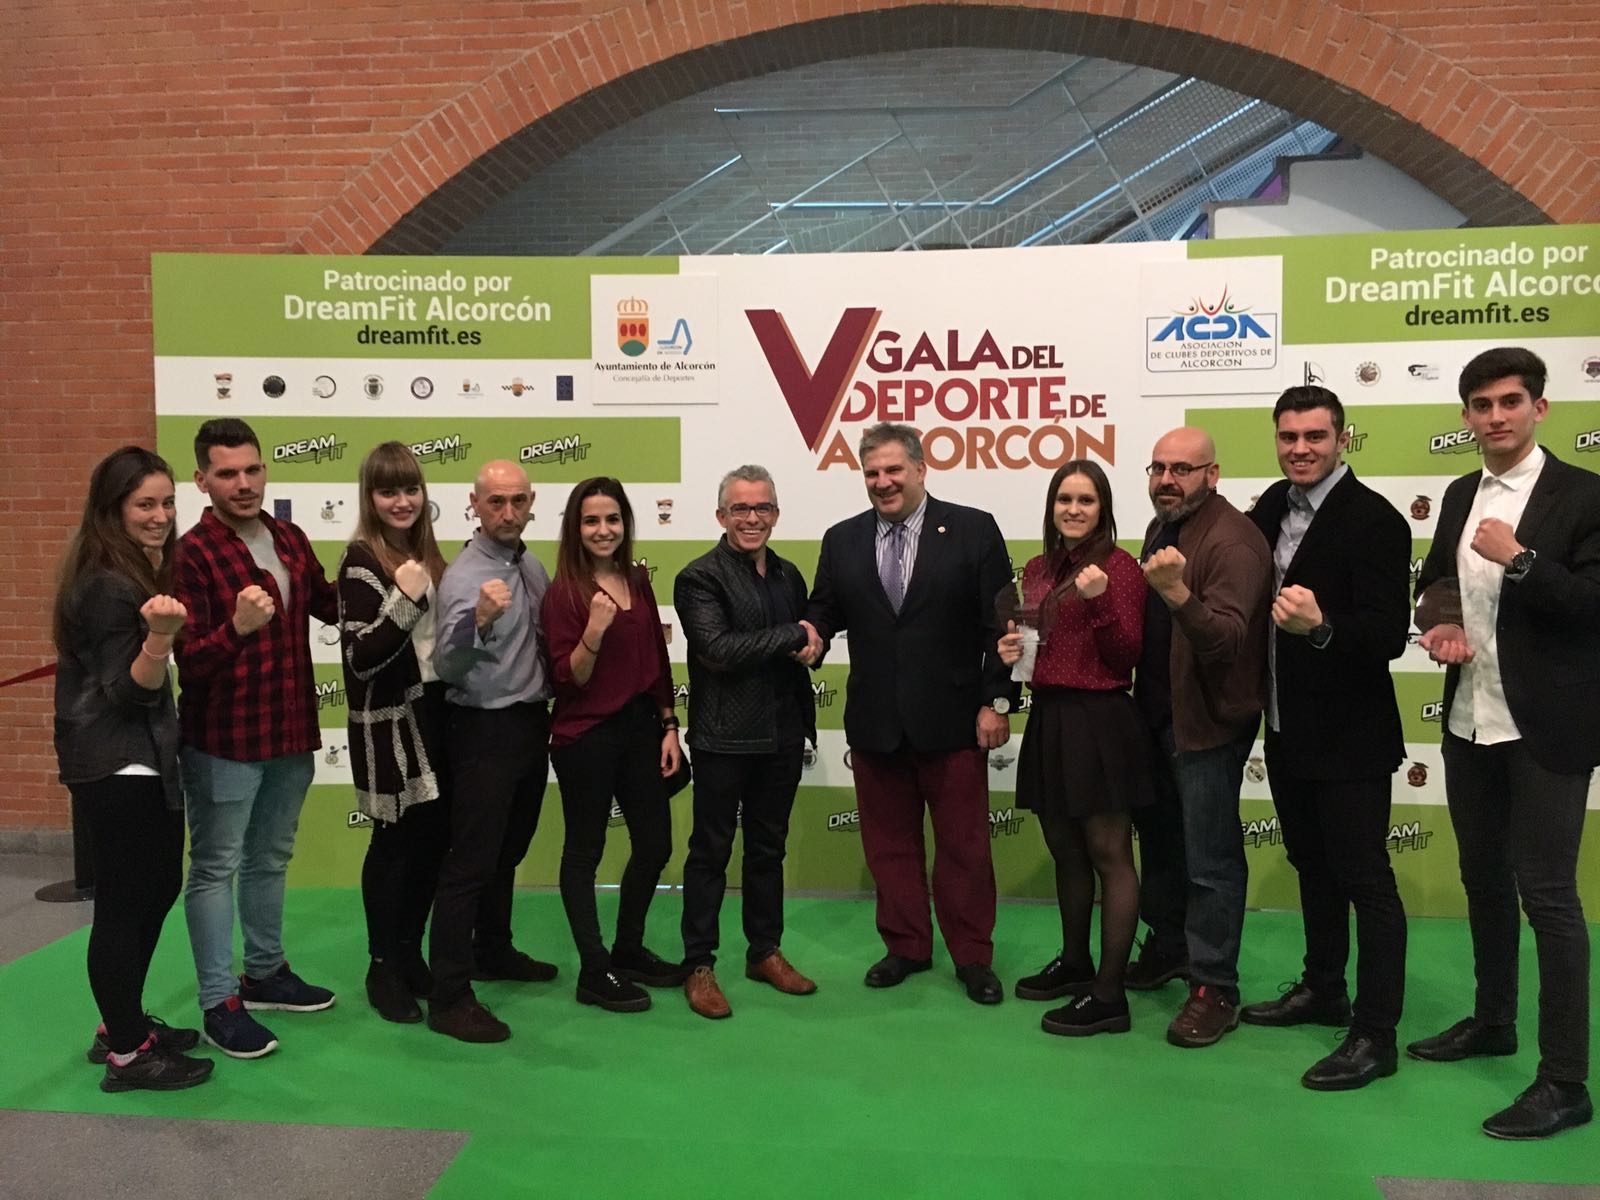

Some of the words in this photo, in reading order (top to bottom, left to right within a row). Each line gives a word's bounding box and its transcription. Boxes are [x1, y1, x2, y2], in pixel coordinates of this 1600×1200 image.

[1370, 241, 1535, 270] Patrocinado
[1543, 245, 1589, 270] por
[323, 270, 467, 292] Patrocinado
[474, 275, 512, 297] por
[1325, 271, 1475, 303] DreamFit
[284, 294, 417, 321] DreamFit
[425, 295, 551, 322] Alcorcón
[1405, 302, 1550, 327] dreamfit.es
[357, 325, 482, 346] dreamfit.es
[865, 329, 1010, 374] GALA
[1012, 345, 1064, 370] DEL
[1165, 350, 1198, 359] CLUBES
[1200, 349, 1258, 358] DEPORTIVOS
[1260, 348, 1272, 356] DE
[1180, 358, 1243, 368] ALCORCÓN
[594, 362, 658, 373] Ayuntamiento
[660, 361, 672, 371] de
[674, 361, 716, 371] Alcorcón
[652, 374, 662, 382] de
[663, 374, 695, 383] Deportes
[744, 307, 883, 454] V
[840, 376, 1067, 423] DEPORTE
[1070, 394, 1107, 418] DE
[273, 433, 336, 461] DREAM
[315, 443, 347, 464] FIT
[408, 434, 460, 456] REAM
[440, 443, 472, 464] FIT
[520, 434, 580, 461] DREAM
[560, 443, 591, 464] FIT
[816, 415, 1116, 471] AORCÓN
